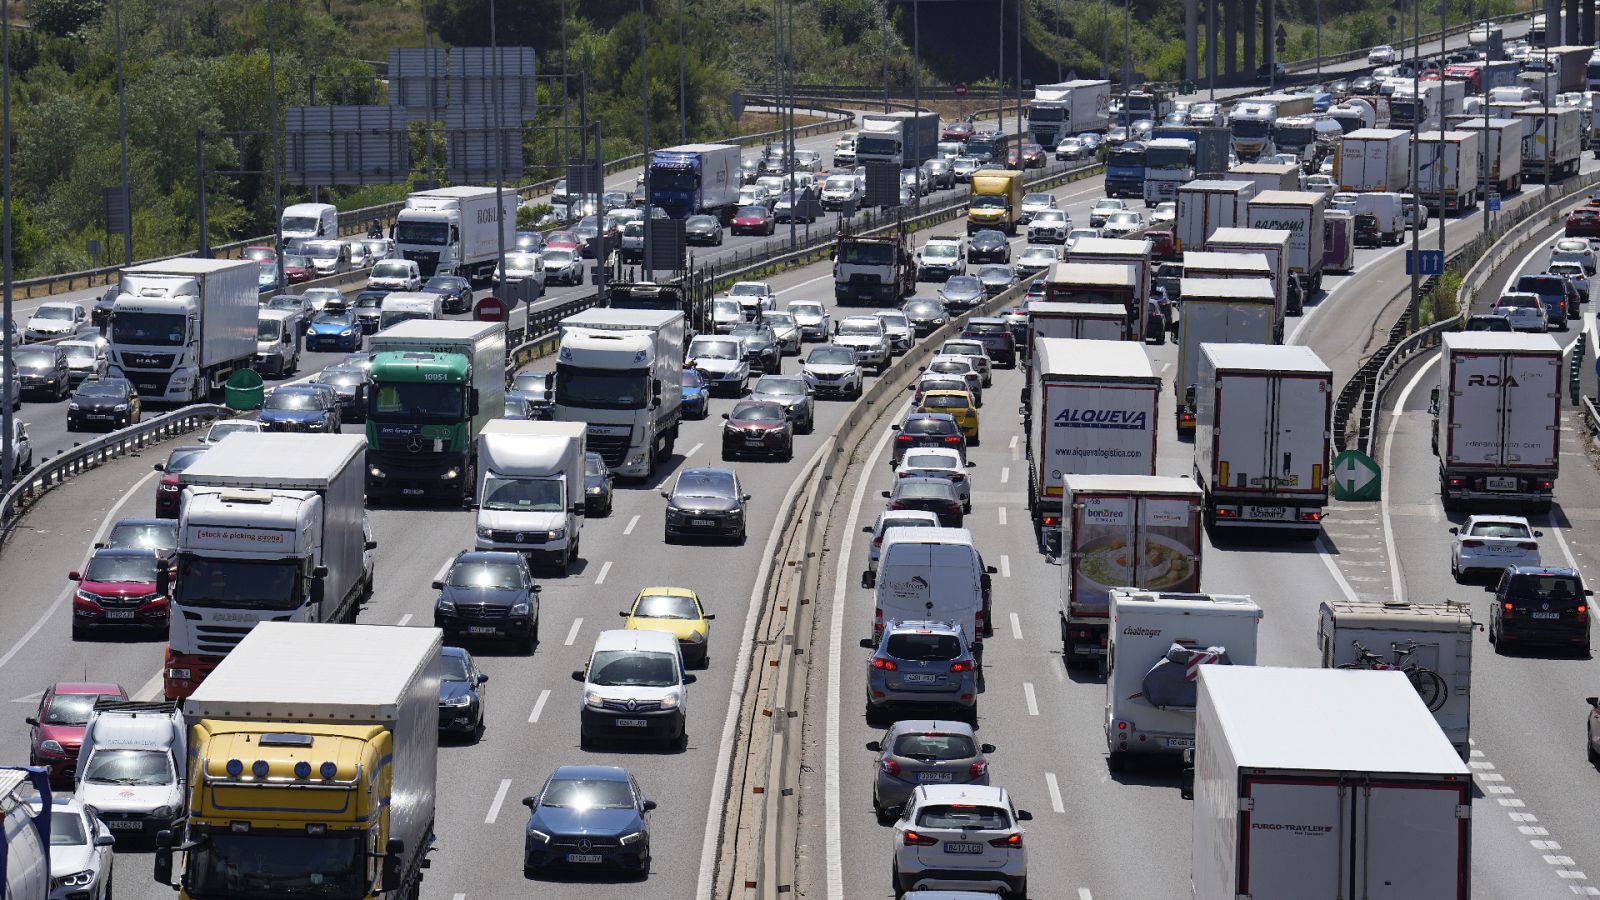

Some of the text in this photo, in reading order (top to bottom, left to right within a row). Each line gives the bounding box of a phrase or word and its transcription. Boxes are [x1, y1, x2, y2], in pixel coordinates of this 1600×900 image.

[1467, 374, 1519, 388] RDA
[1055, 408, 1147, 425] ALQUEVA
[1055, 447, 1142, 459] www.alquevalogistica.com
[229, 533, 256, 541] picking
[1251, 823, 1324, 832] FURGO-TRAYLER
